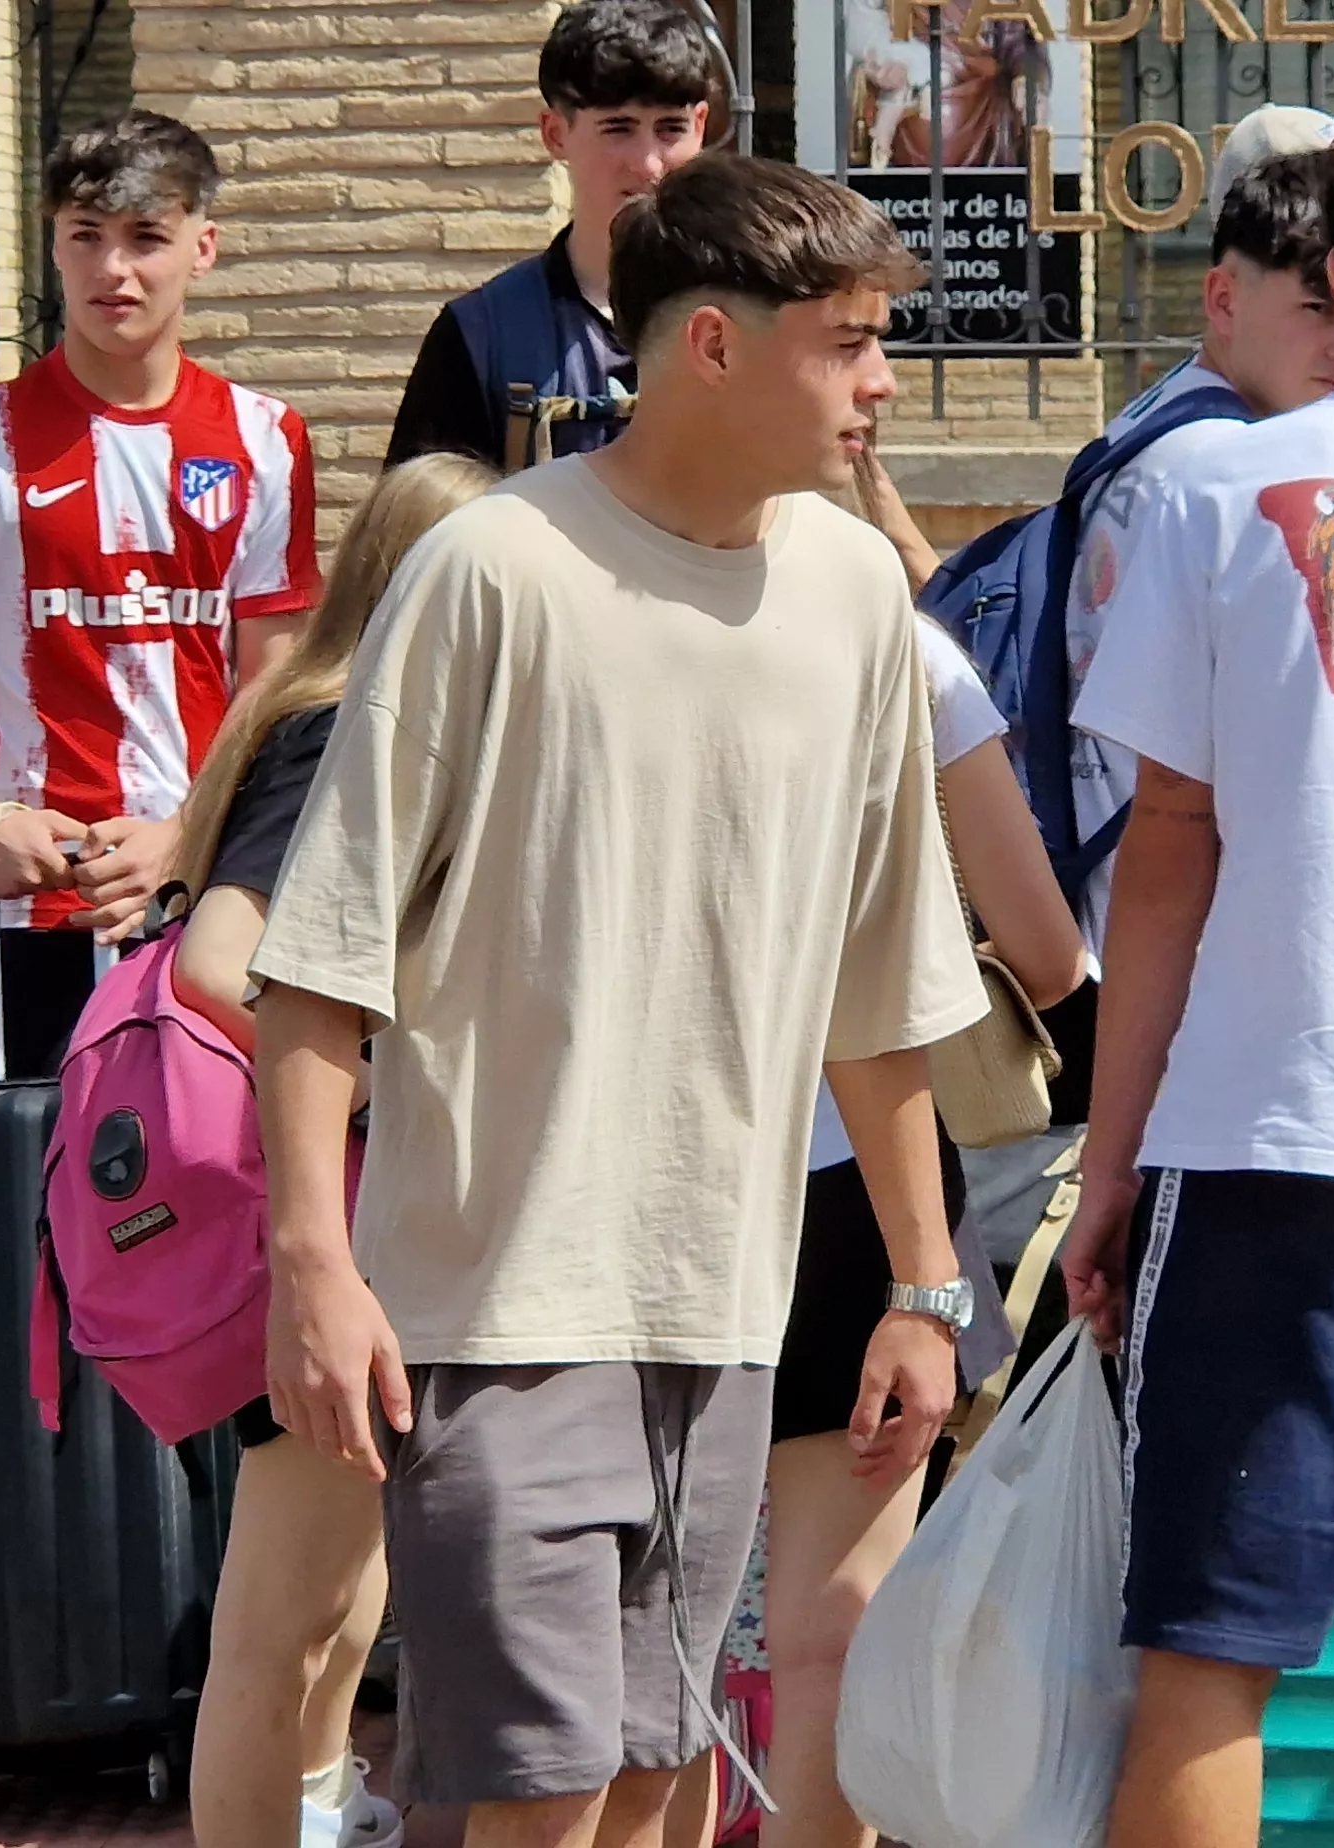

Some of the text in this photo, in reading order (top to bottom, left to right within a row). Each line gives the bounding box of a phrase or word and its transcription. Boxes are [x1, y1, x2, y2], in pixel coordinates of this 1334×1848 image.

[964, 192, 1000, 219] de
[976, 222, 1011, 249] de
[1017, 223, 1056, 249] ls
[29, 584, 229, 629] Plus500
